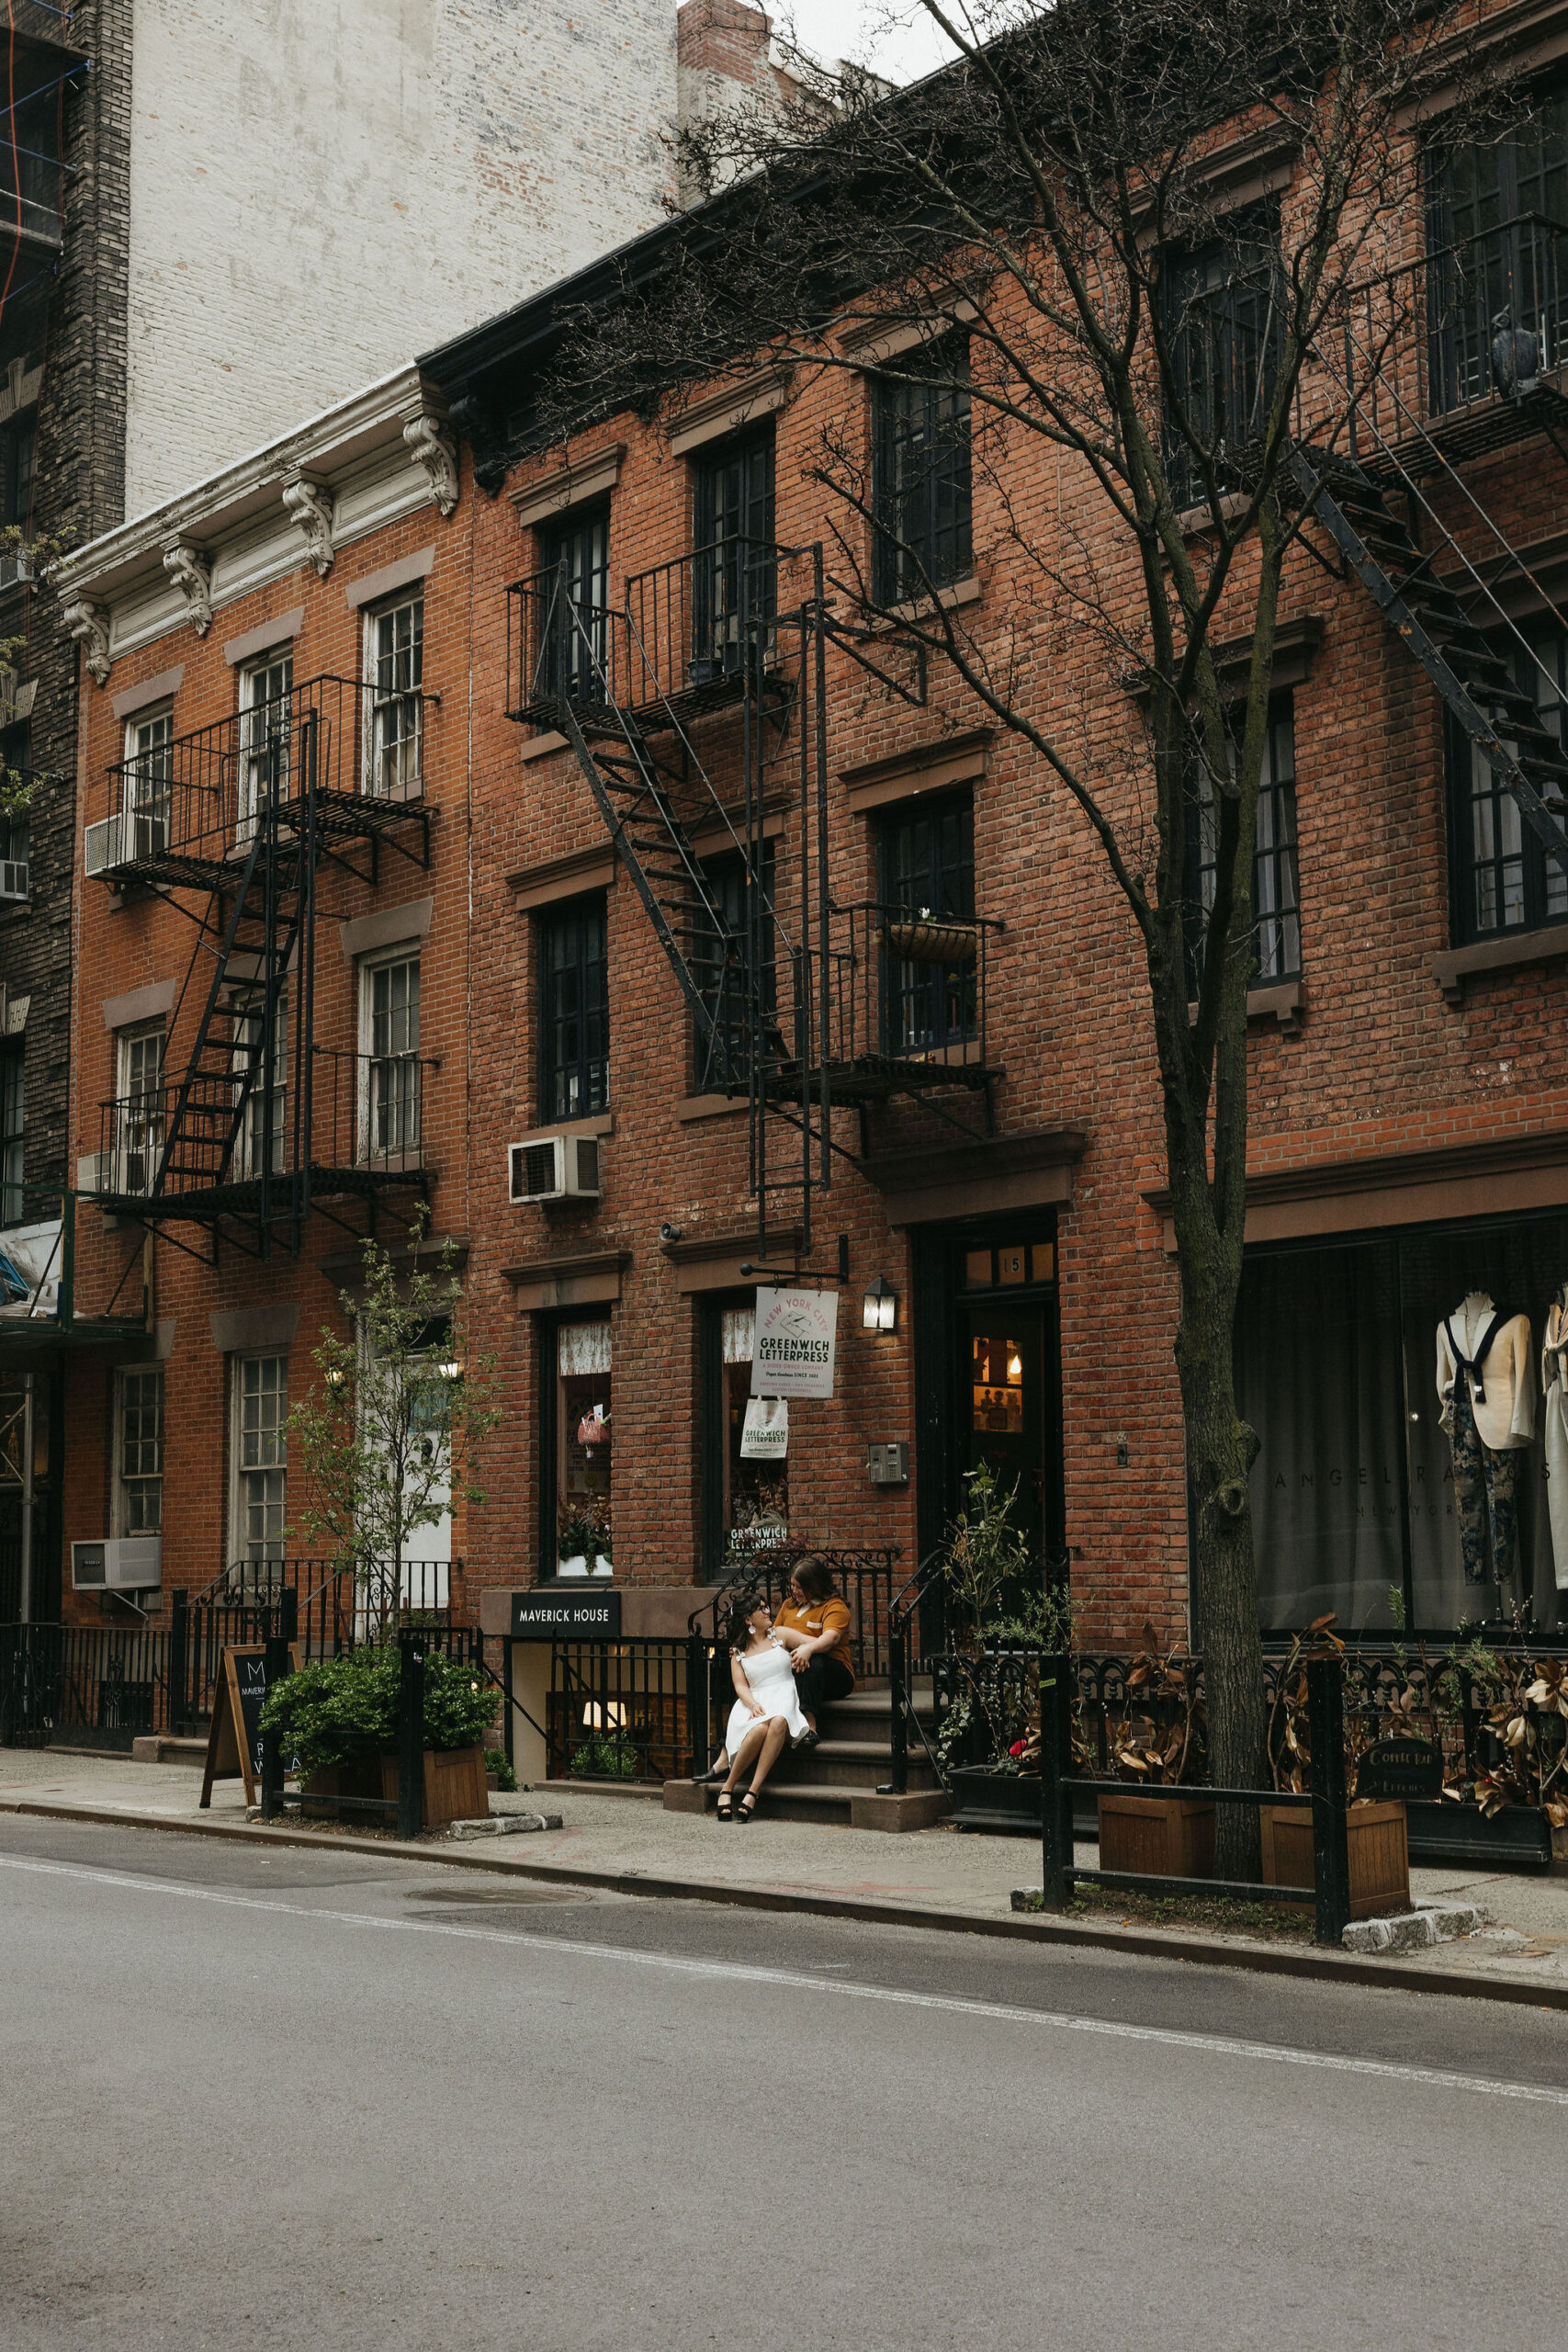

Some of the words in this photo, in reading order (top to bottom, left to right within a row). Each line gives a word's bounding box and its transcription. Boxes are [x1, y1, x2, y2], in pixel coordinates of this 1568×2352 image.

[764, 1303, 782, 1329] NEW
[785, 1297, 812, 1311] YORK
[813, 1308, 829, 1331] CITY
[760, 1338, 829, 1351] GREENWICH
[759, 1349, 829, 1363] LETTERPRESS
[1274, 1465, 1391, 1489] ANGEL
[519, 1610, 570, 1623] MAVERICK
[573, 1609, 609, 1622] HOUSE
[247, 1660, 266, 1684] M
